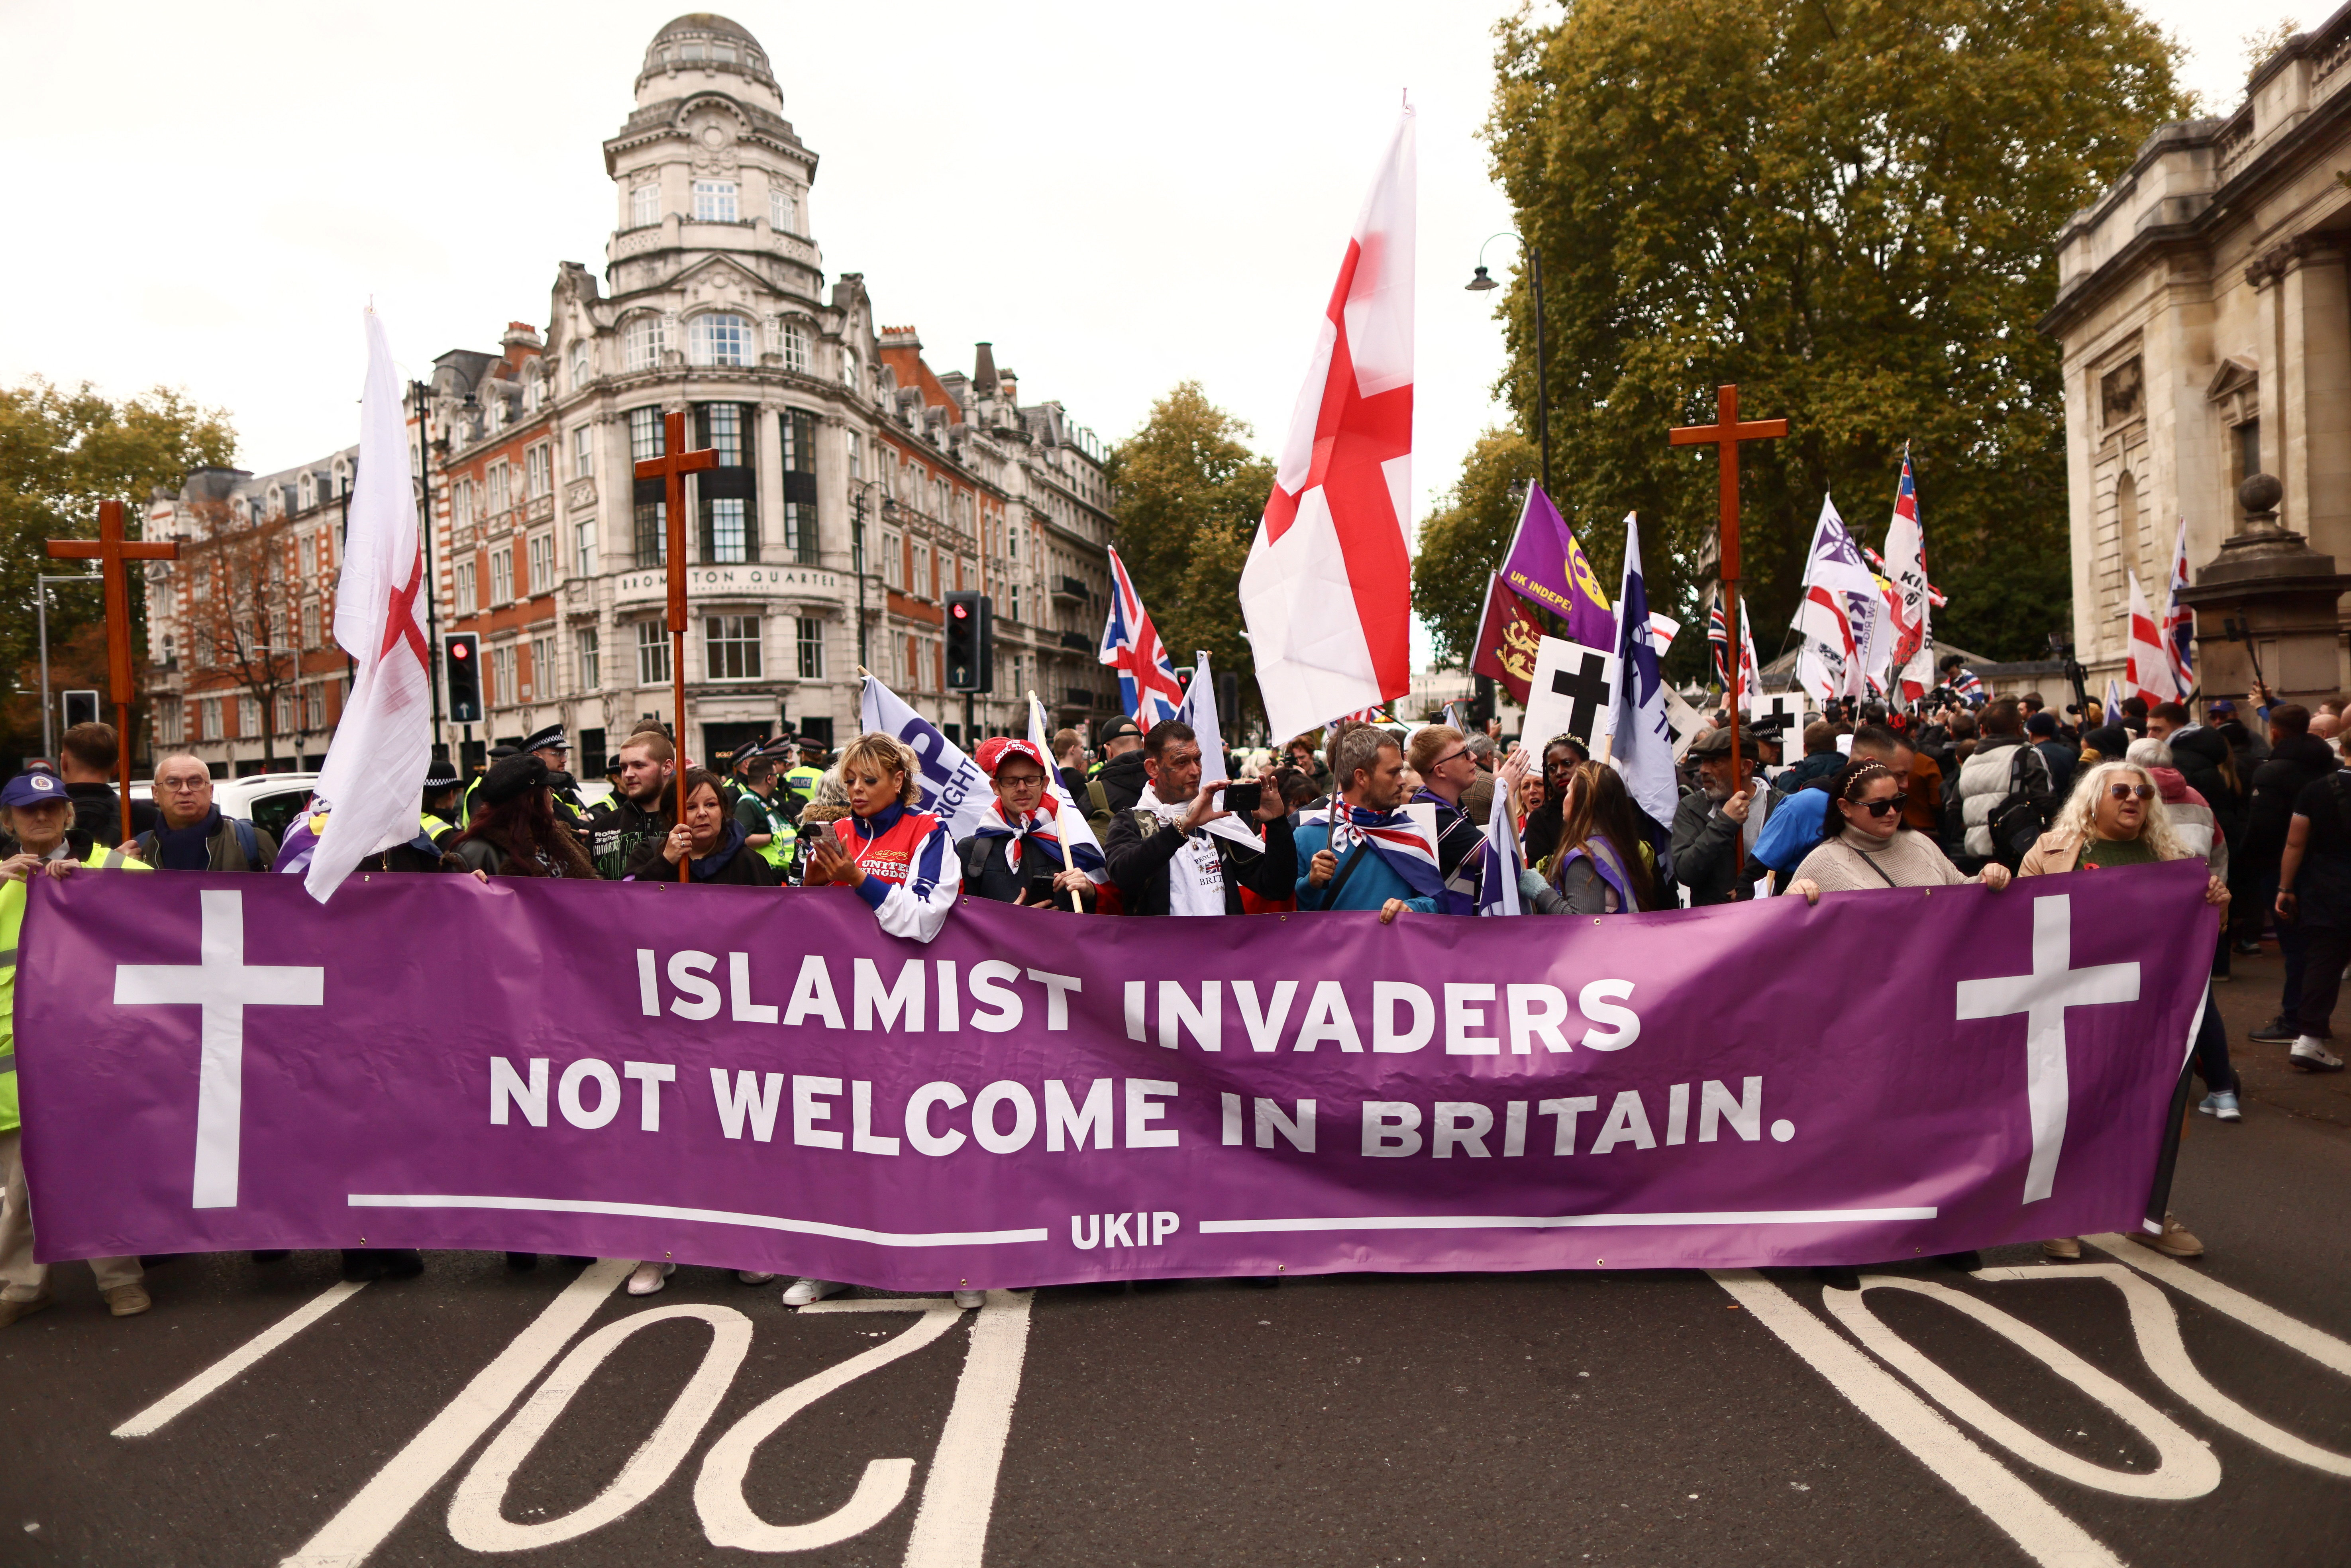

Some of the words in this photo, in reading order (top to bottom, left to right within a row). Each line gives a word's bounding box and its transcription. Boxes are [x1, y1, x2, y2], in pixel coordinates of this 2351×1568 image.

[623, 571, 733, 589] BROMTON
[751, 571, 834, 587] QUARTER
[1511, 571, 1528, 586] UK
[995, 746, 1009, 760] MAKE
[1011, 744, 1035, 754] BRITAIN
[791, 777, 811, 787] POLICE
[933, 757, 979, 818] RIGHT
[595, 829, 621, 837] ROSES
[1194, 851, 1216, 865] PROUD
[859, 867, 909, 879] KINGDO
[636, 948, 1082, 1034] ISLAMIST
[1124, 978, 1641, 1056] INVADERS
[490, 1056, 676, 1132] NOT
[709, 1067, 1179, 1157] WELCOME
[1221, 1091, 1317, 1153] IN
[1361, 1075, 1796, 1159] BRITAIN.
[1071, 1211, 1180, 1250] UKIP
